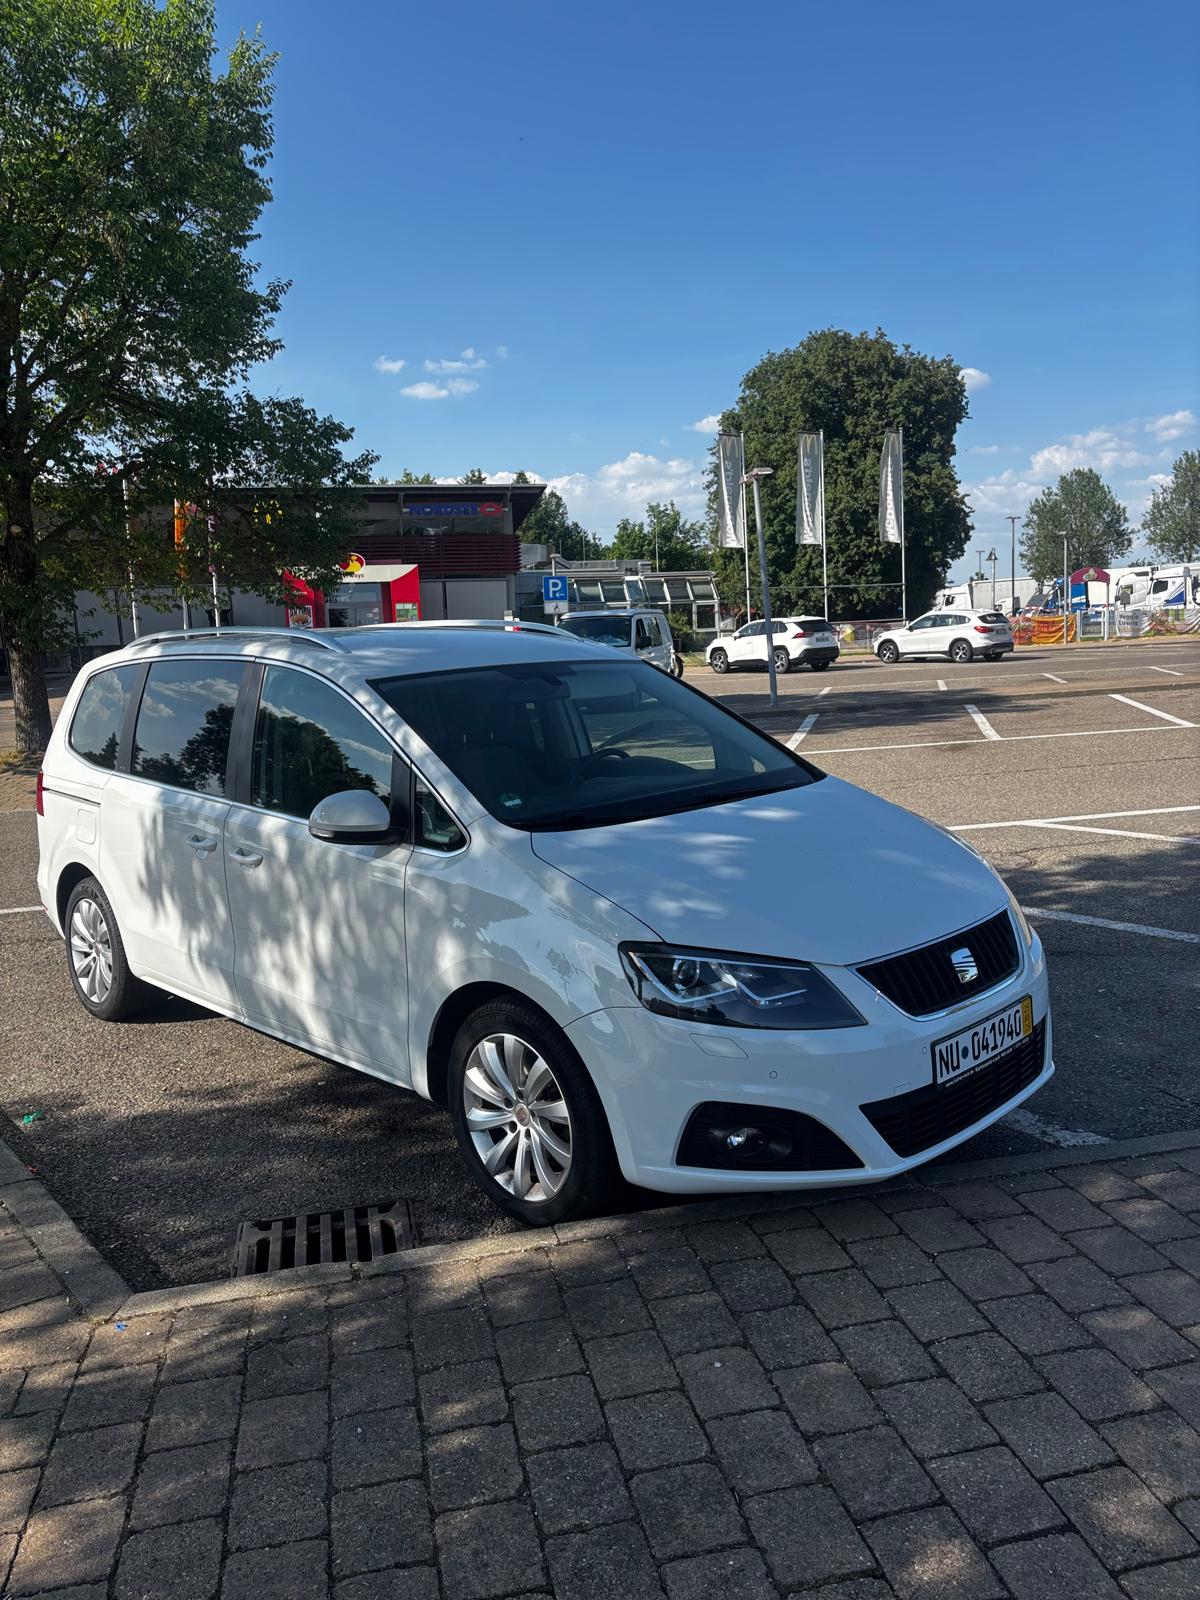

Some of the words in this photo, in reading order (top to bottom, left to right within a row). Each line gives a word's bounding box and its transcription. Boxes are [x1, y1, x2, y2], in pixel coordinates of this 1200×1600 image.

[548, 579, 561, 598] P
[939, 1040, 960, 1078] NU
[971, 1009, 1022, 1061] 041940
